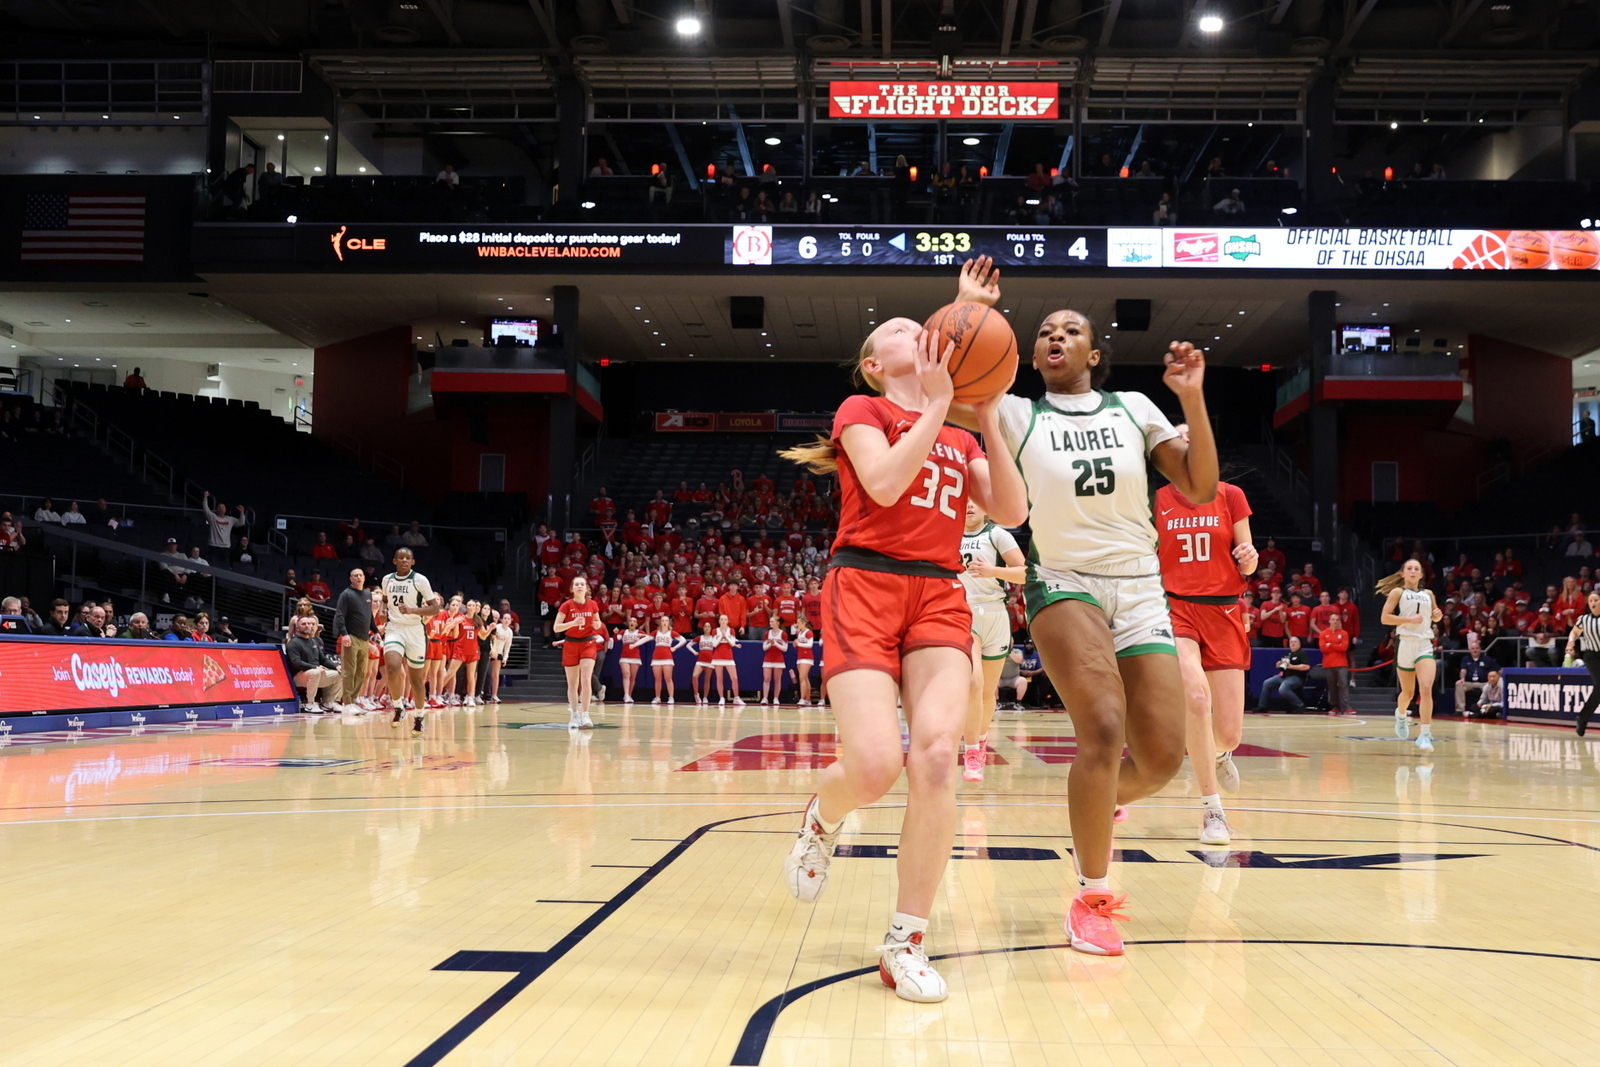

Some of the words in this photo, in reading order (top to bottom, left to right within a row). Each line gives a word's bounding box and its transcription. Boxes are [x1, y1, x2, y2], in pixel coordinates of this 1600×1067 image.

[879, 84, 918, 96] THE
[928, 84, 1009, 97] CONNOR
[851, 95, 955, 115] FLIGHT
[962, 96, 1038, 116] DECK
[346, 238, 386, 250] CLE
[419, 232, 449, 243] Place
[450, 234, 457, 243] a
[458, 231, 480, 244] $28
[481, 232, 512, 243] initial
[513, 232, 554, 246] deposit
[555, 234, 568, 243] or
[569, 232, 619, 246] purchase
[619, 235, 645, 246] gear
[646, 233, 681, 246] today!
[839, 232, 853, 241] TOL
[856, 232, 880, 241] FOULS
[915, 232, 971, 252] 3:33
[1006, 233, 1030, 241] FOULS
[1031, 233, 1046, 241] TOL
[1287, 229, 1352, 246] OFFICIAL
[1358, 229, 1454, 246] BASKETBALL
[478, 246, 621, 258] WNBACLEVELAND.COM
[798, 235, 818, 259] 6
[841, 242, 851, 257] 5
[862, 242, 872, 257] 0
[1014, 243, 1025, 258] 0
[1034, 243, 1045, 258] 5
[1067, 236, 1089, 261] 4
[933, 254, 954, 265] 1ST
[1316, 249, 1336, 266] OF
[1342, 250, 1369, 267] THE
[1374, 250, 1426, 267] OHSAA
[730, 417, 762, 427] LOYOLA
[1050, 427, 1125, 452] LAUREL
[1071, 456, 1116, 497] 25
[910, 459, 965, 521] 32
[1166, 515, 1220, 531] BELLEVUE
[1176, 532, 1211, 563] 30
[389, 585, 409, 594] LAUREL
[467, 630, 475, 640] 13
[656, 636, 670, 644] BHS
[52, 666, 71, 681] Join
[71, 653, 125, 697] Casey's
[126, 667, 173, 685] REWARDS
[172, 667, 195, 685] today!
[1507, 683, 1561, 711] DAYTON
